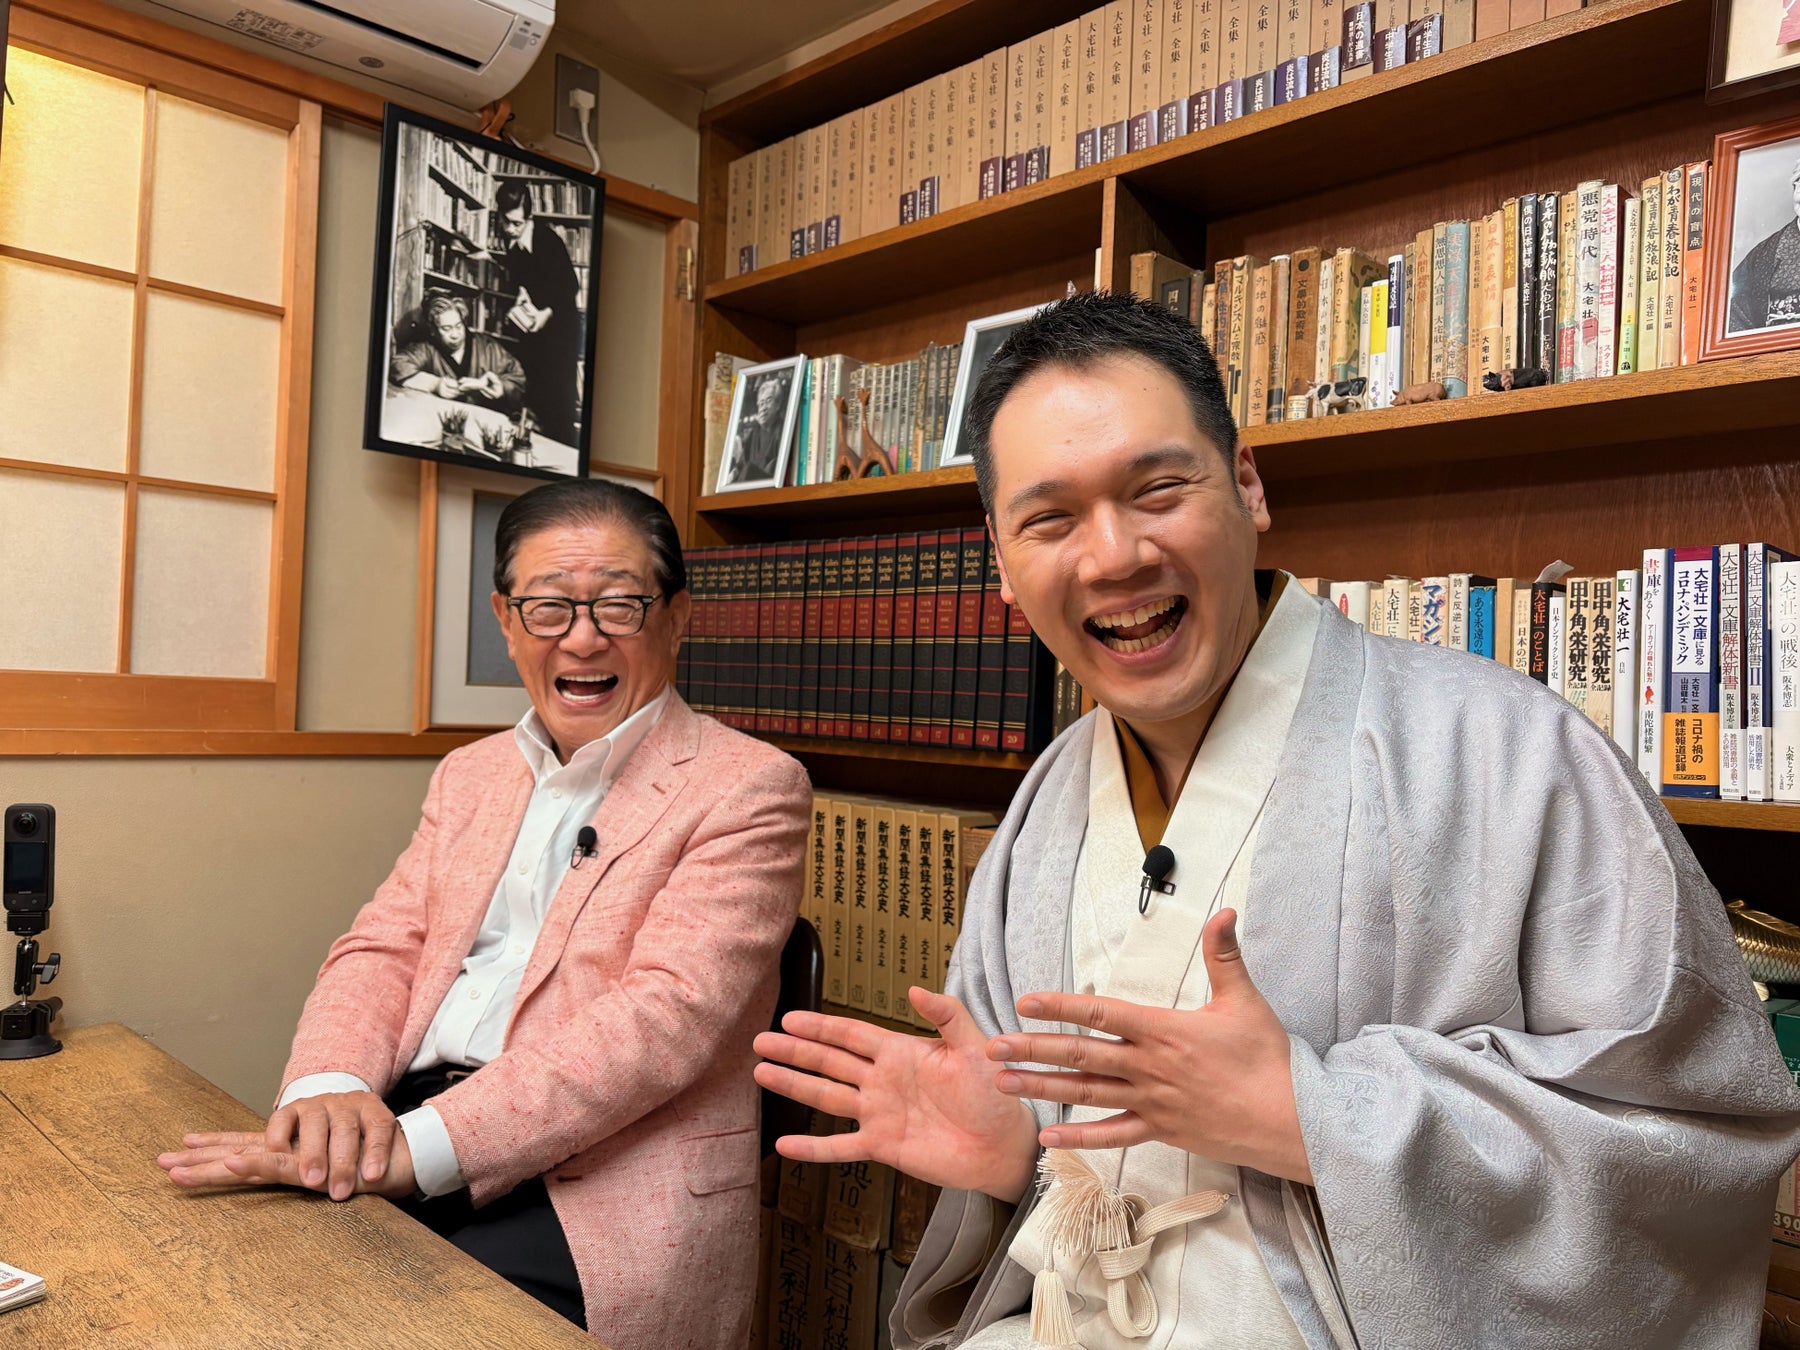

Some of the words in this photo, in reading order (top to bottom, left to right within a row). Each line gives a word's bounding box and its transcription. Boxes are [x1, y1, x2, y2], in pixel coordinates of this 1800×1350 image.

[1112, 10, 1123, 85] 大宅壮一全集
[1228, 0, 1240, 42] 一全集
[1384, 32, 1394, 71] 中学生日
[1036, 44, 1045, 114] 大宅壮一全集
[1060, 33, 1072, 106] 大宅壮一全集
[1086, 22, 1097, 95] 大宅壮一全集
[1581, 190, 1599, 261] 悪党時代
[1645, 185, 1660, 282] わが青春放浪記
[1664, 185, 1681, 278] わが青春放浪記
[1689, 177, 1702, 247] 現代の盲点
[1582, 282, 1594, 330] 大宅壮一
[1688, 277, 1698, 309] 大宅壮一
[1481, 336, 1490, 371] 大宅壮一
[1387, 588, 1400, 638] 大宅壮一に
[1451, 578, 1463, 645] 詩と反逆と死
[1643, 558, 1661, 620] 書庫をあるく
[1675, 570, 1691, 665] コロナ・パンデミック
[1692, 567, 1709, 666] 大宅壮一文庫に見る
[1721, 551, 1739, 690] 大宅壮一文庫解体新書
[1780, 571, 1798, 673] 大宅壮一の「戦後」
[1532, 590, 1547, 673] 大宅壮一のことば
[1551, 607, 1560, 680] 日本ノンフィクション史
[1568, 581, 1589, 682] 田中角栄研究
[1591, 581, 1612, 684] 田中角栄研究
[1616, 597, 1631, 653] 大宅壮一
[1567, 682, 1588, 690] 全記録
[1591, 683, 1611, 692] 全記録
[1619, 662, 1626, 674] 自伝
[1680, 677, 1689, 704] 山田健太
[1782, 675, 1792, 708] 阪本博志
[1691, 718, 1703, 764] コロナ禍の
[1726, 693, 1735, 723] 阪本博志
[1750, 693, 1759, 723] 阪本博志
[1674, 718, 1687, 772] 雑誌報道記録
[1785, 745, 1795, 791] 大衆とメディア
[814, 811, 825, 899] 新聞集録大正史
[834, 815, 846, 905] 新聞集録大正史
[855, 817, 867, 909] 新聞集録大正史
[877, 820, 889, 913] 新聞集録大正史
[898, 824, 911, 918] 新聞集録大正史
[919, 827, 932, 922] 新聞集録大正史
[942, 829, 956, 927] 新聞集録大正史
[839, 1181, 860, 1208] 10
